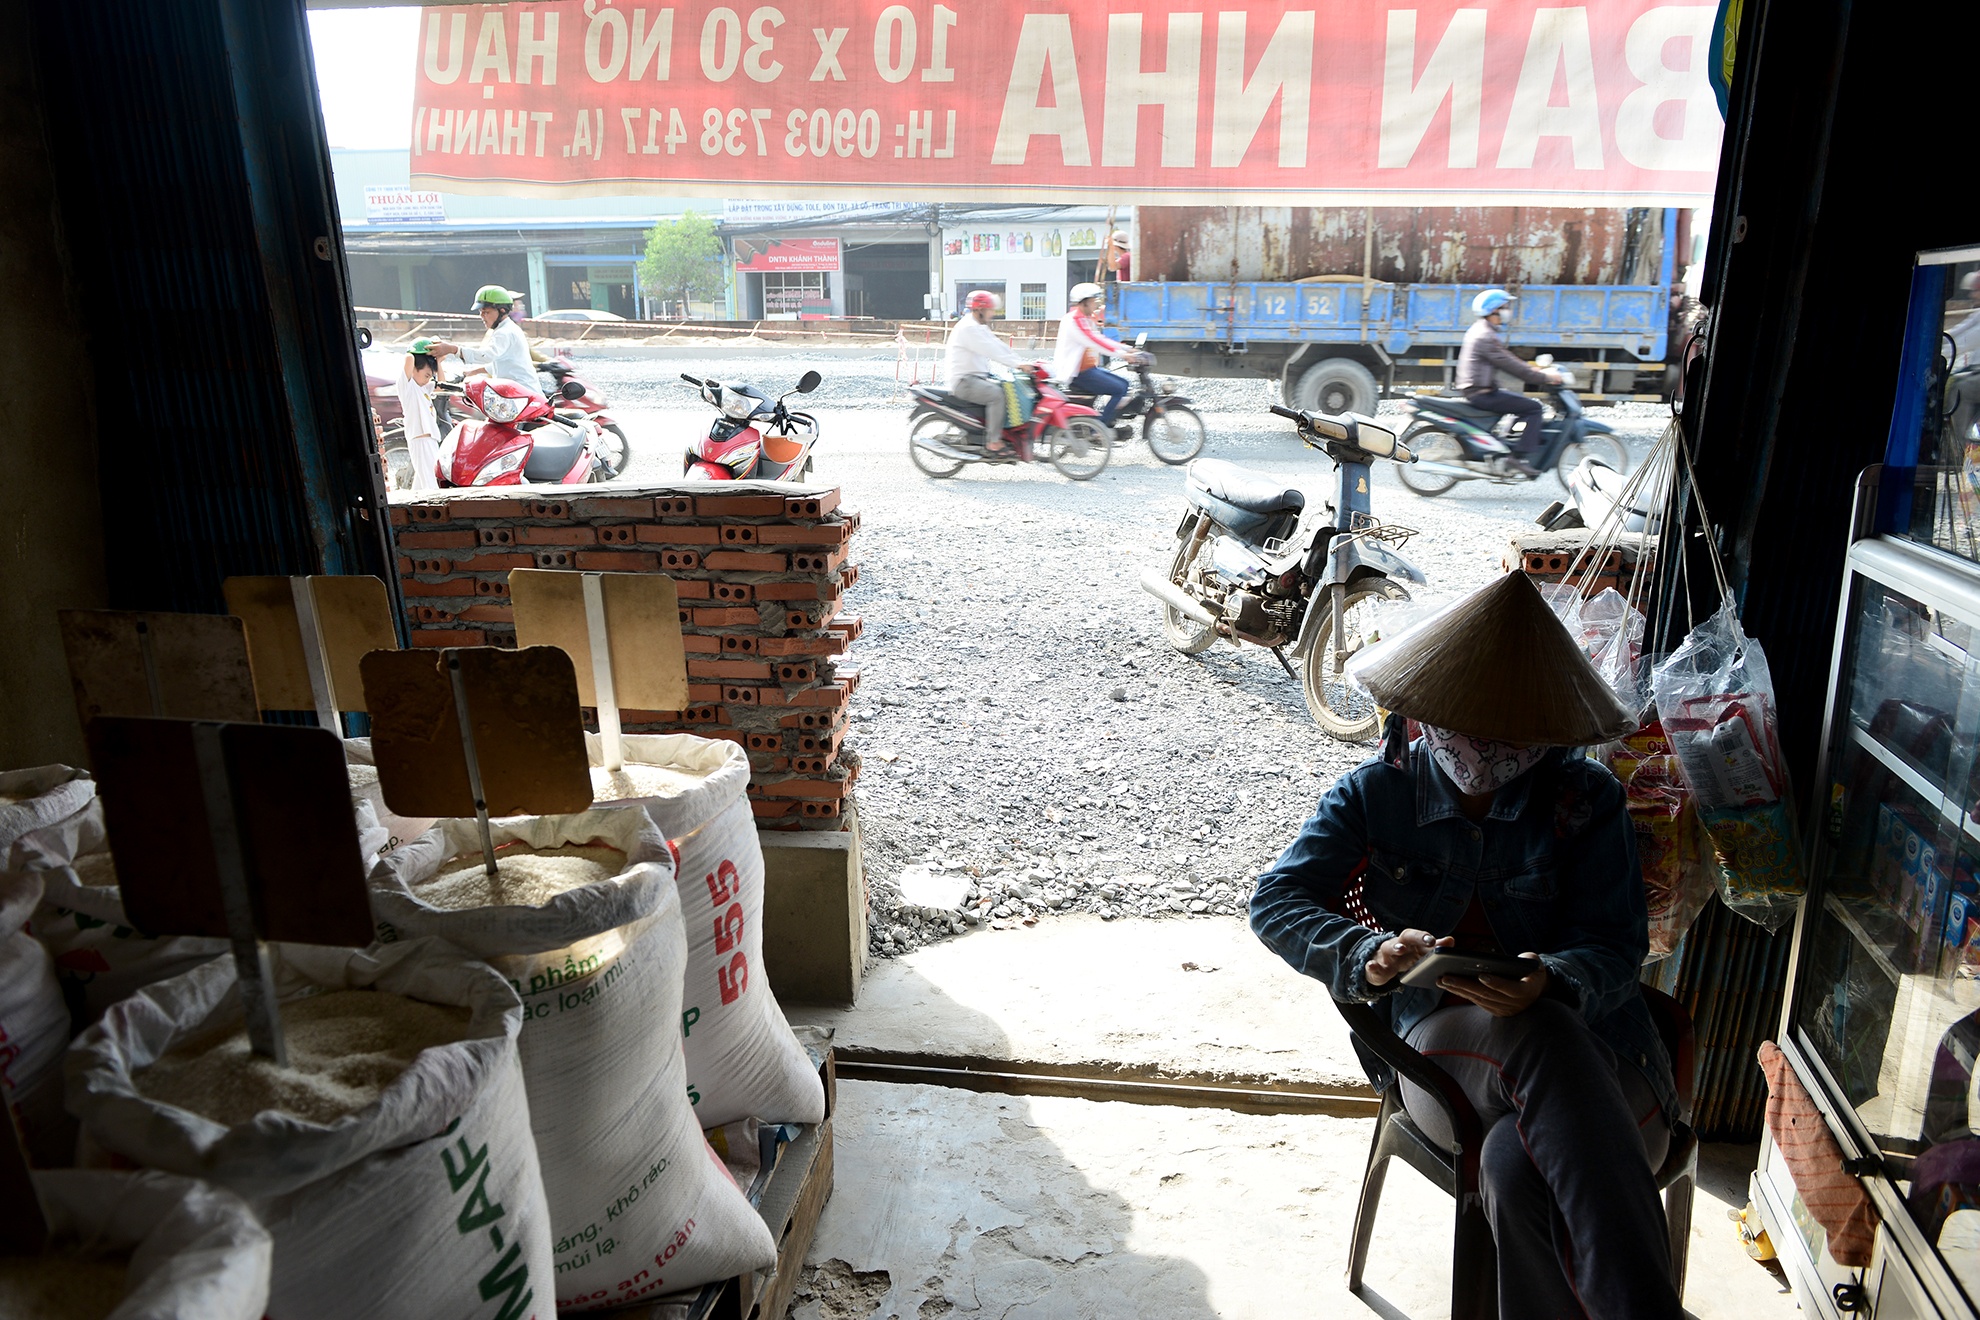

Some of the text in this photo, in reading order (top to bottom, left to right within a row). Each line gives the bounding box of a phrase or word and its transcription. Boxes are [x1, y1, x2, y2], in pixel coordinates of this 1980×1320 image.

[417, 193, 439, 205] LỢI
[1264, 296, 1286, 314] 12
[1307, 296, 1330, 314] 52
[523, 1001, 550, 1022] ác
[606, 1185, 639, 1222] khô
[617, 1269, 650, 1292] an
[654, 1218, 696, 1268] toàn
